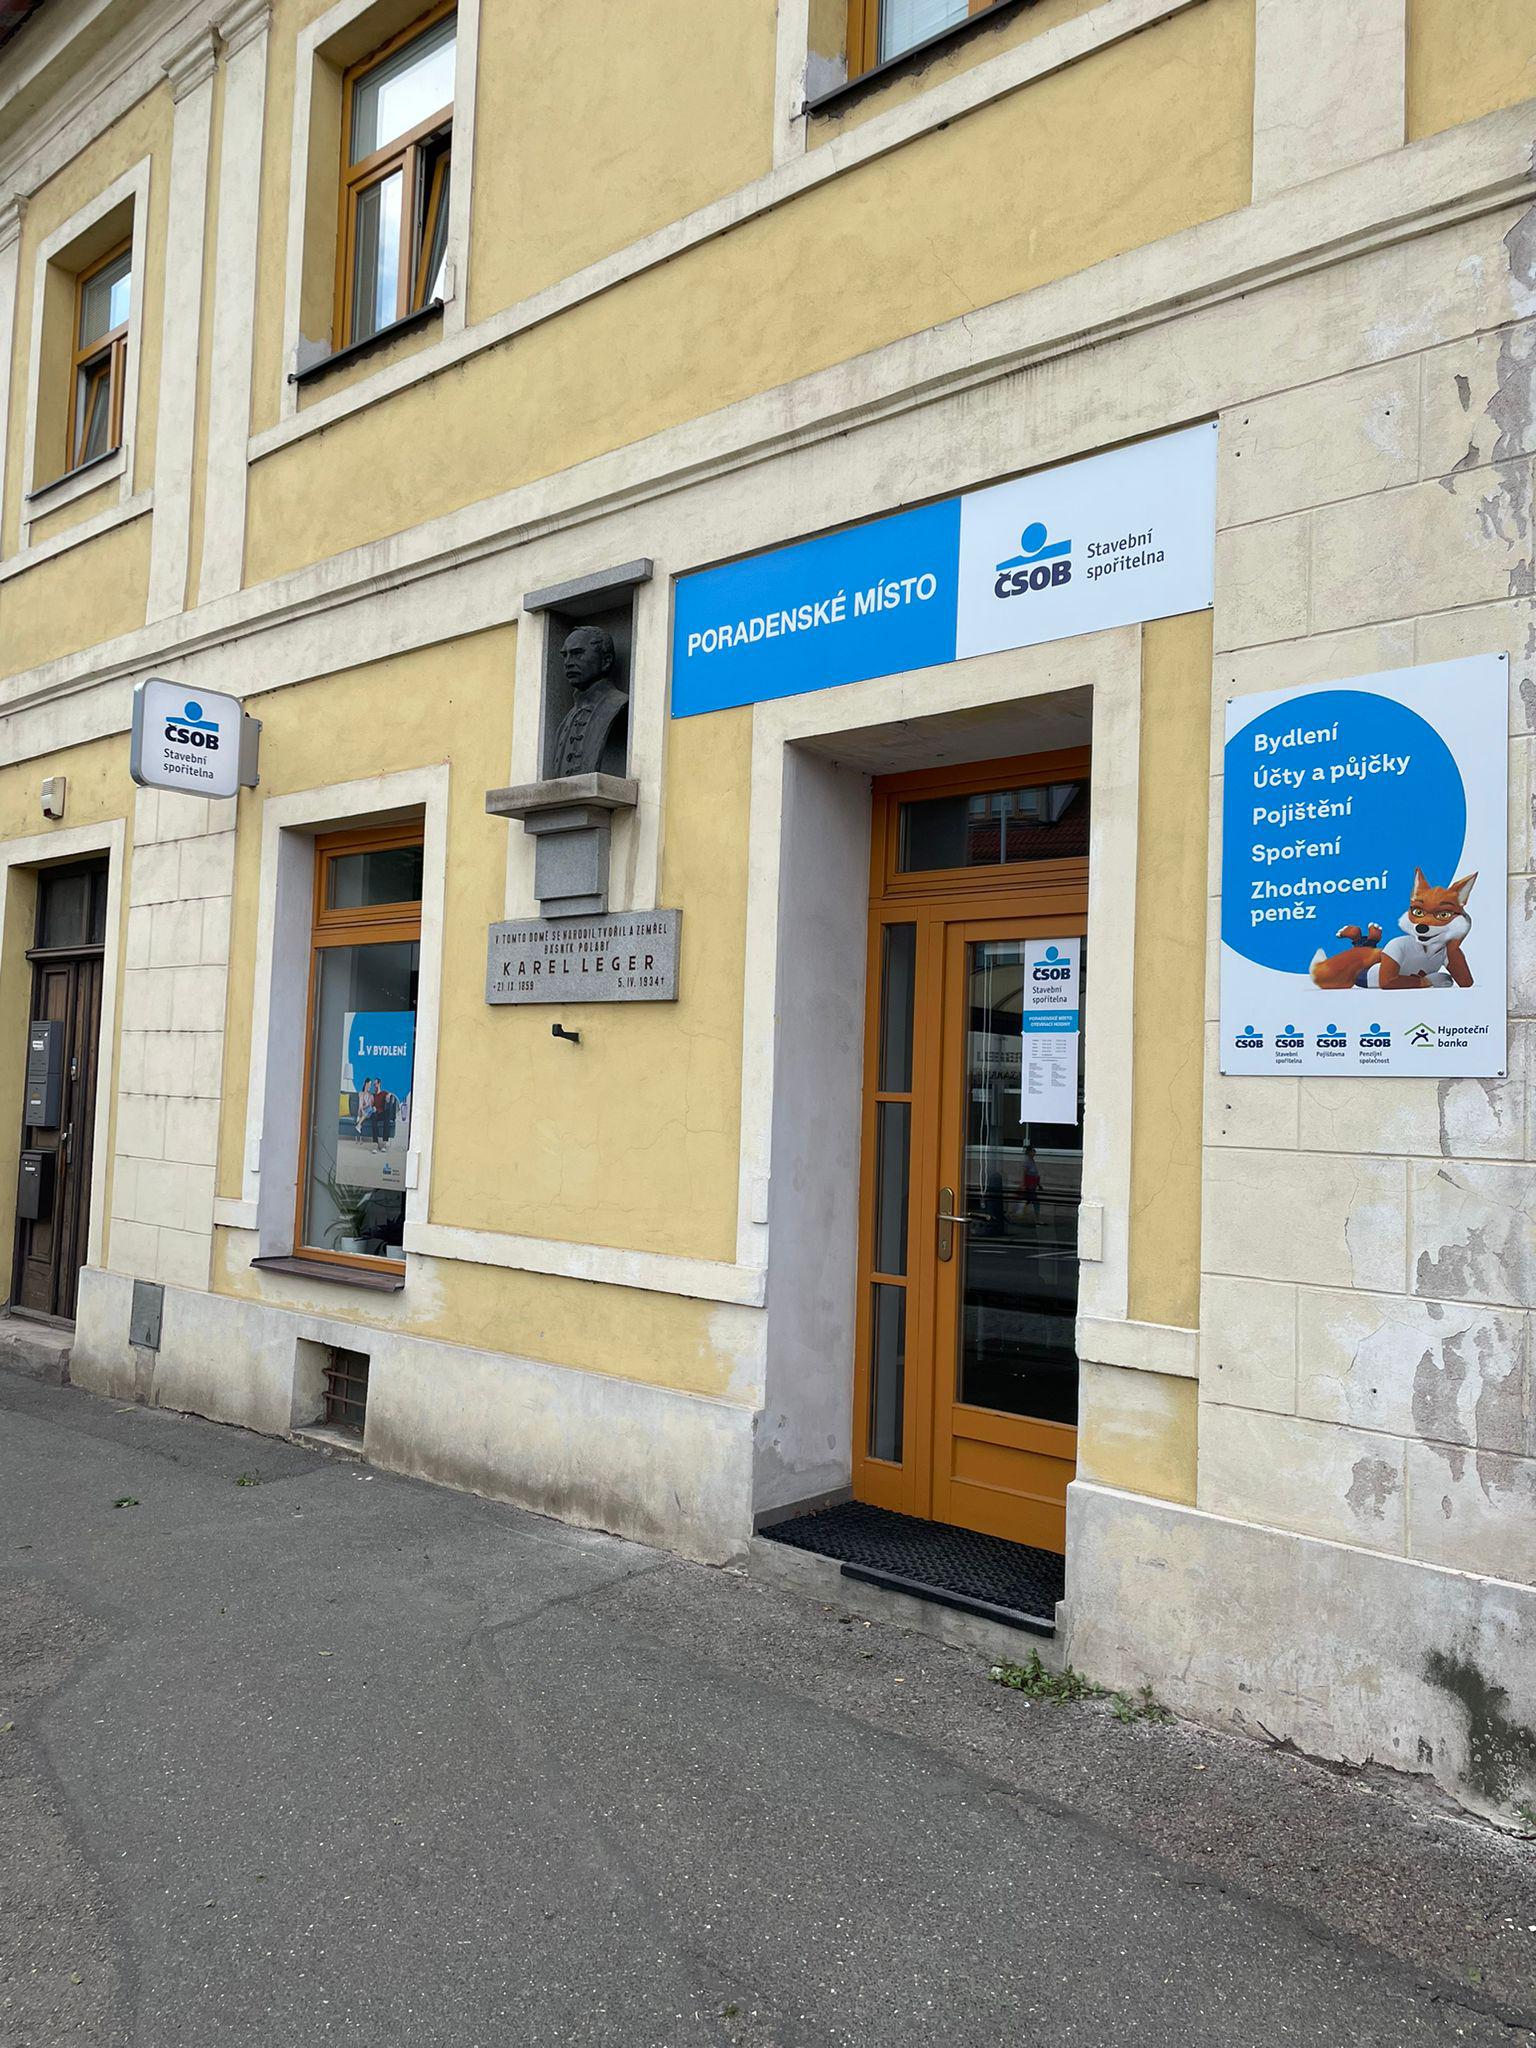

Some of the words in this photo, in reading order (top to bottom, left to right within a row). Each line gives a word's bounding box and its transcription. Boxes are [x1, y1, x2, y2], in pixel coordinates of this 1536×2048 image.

[1087, 528, 1153, 558] Stavební
[1086, 549, 1165, 581] spořitelna
[994, 560, 1072, 599] ČSOB
[687, 589, 846, 657] PORADENSKÉ
[853, 572, 937, 614] MÍSTO
[164, 723, 219, 750] ČSOB
[1254, 722, 1339, 755] Bydlení
[163, 748, 207, 765] Stavební
[163, 762, 214, 779] spořitelna
[1253, 764, 1306, 790] Účty
[1312, 767, 1325, 780] a
[1330, 752, 1411, 784] půjčky
[1252, 796, 1353, 827] Pojištění
[1251, 836, 1342, 865] Spoření
[1250, 871, 1389, 900] Zhodnocení
[1250, 902, 1317, 927] peněz
[502, 932, 527, 944] TOMTO
[552, 930, 561, 941] SE
[598, 925, 626, 938] TVOŘIL
[629, 925, 634, 936] A
[636, 921, 668, 936] ZEMŘEL
[503, 960, 570, 977] KAREL
[582, 954, 654, 973] LEGER
[1032, 967, 1071, 981] ČSOB
[518, 980, 534, 991] 1859
[1032, 985, 1062, 994] Stavební
[1032, 995, 1068, 1004] spořitelna
[1437, 1025, 1489, 1037] Hypoteční
[358, 1036, 364, 1056] 1
[366, 1045, 371, 1056] V
[373, 1042, 406, 1056] BYDLENÍ
[1235, 1038, 1264, 1048] ČSOB
[1275, 1038, 1305, 1048] ČSOB
[1316, 1038, 1347, 1048] ČSOB
[1359, 1037, 1391, 1048] ČSOB
[1437, 1038, 1468, 1048] banka
